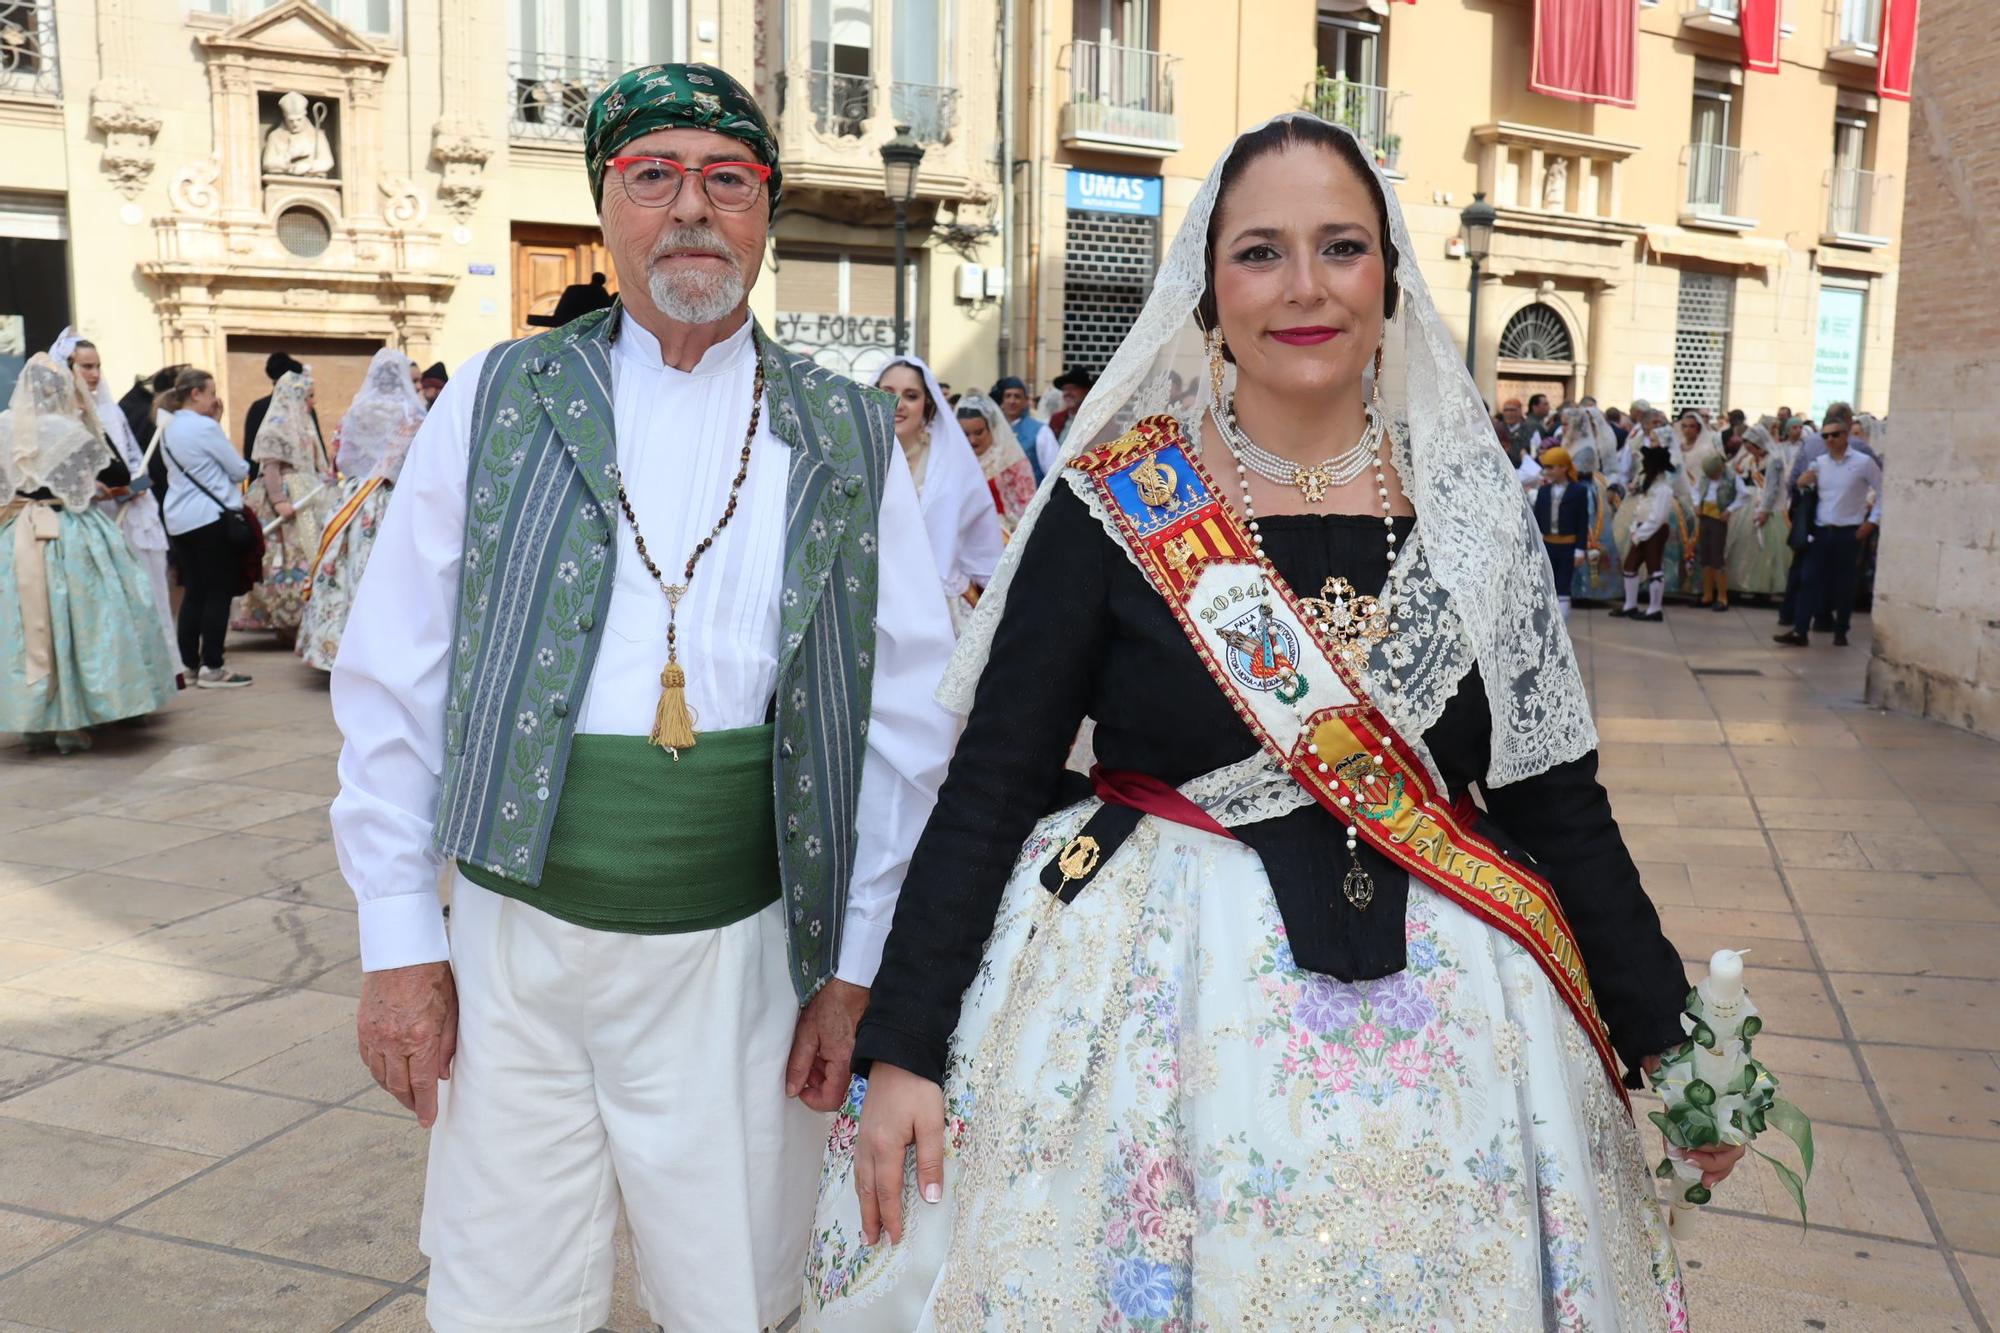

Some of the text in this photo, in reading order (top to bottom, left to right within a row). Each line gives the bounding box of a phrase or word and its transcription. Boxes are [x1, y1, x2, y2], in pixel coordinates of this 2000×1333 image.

[1079, 172, 1144, 201] UMAS
[1200, 583, 1260, 623] 2024
[1234, 614, 1256, 629] FALLA
[1236, 670, 1253, 684] MORA
[1389, 807, 1548, 941] FALLERA
